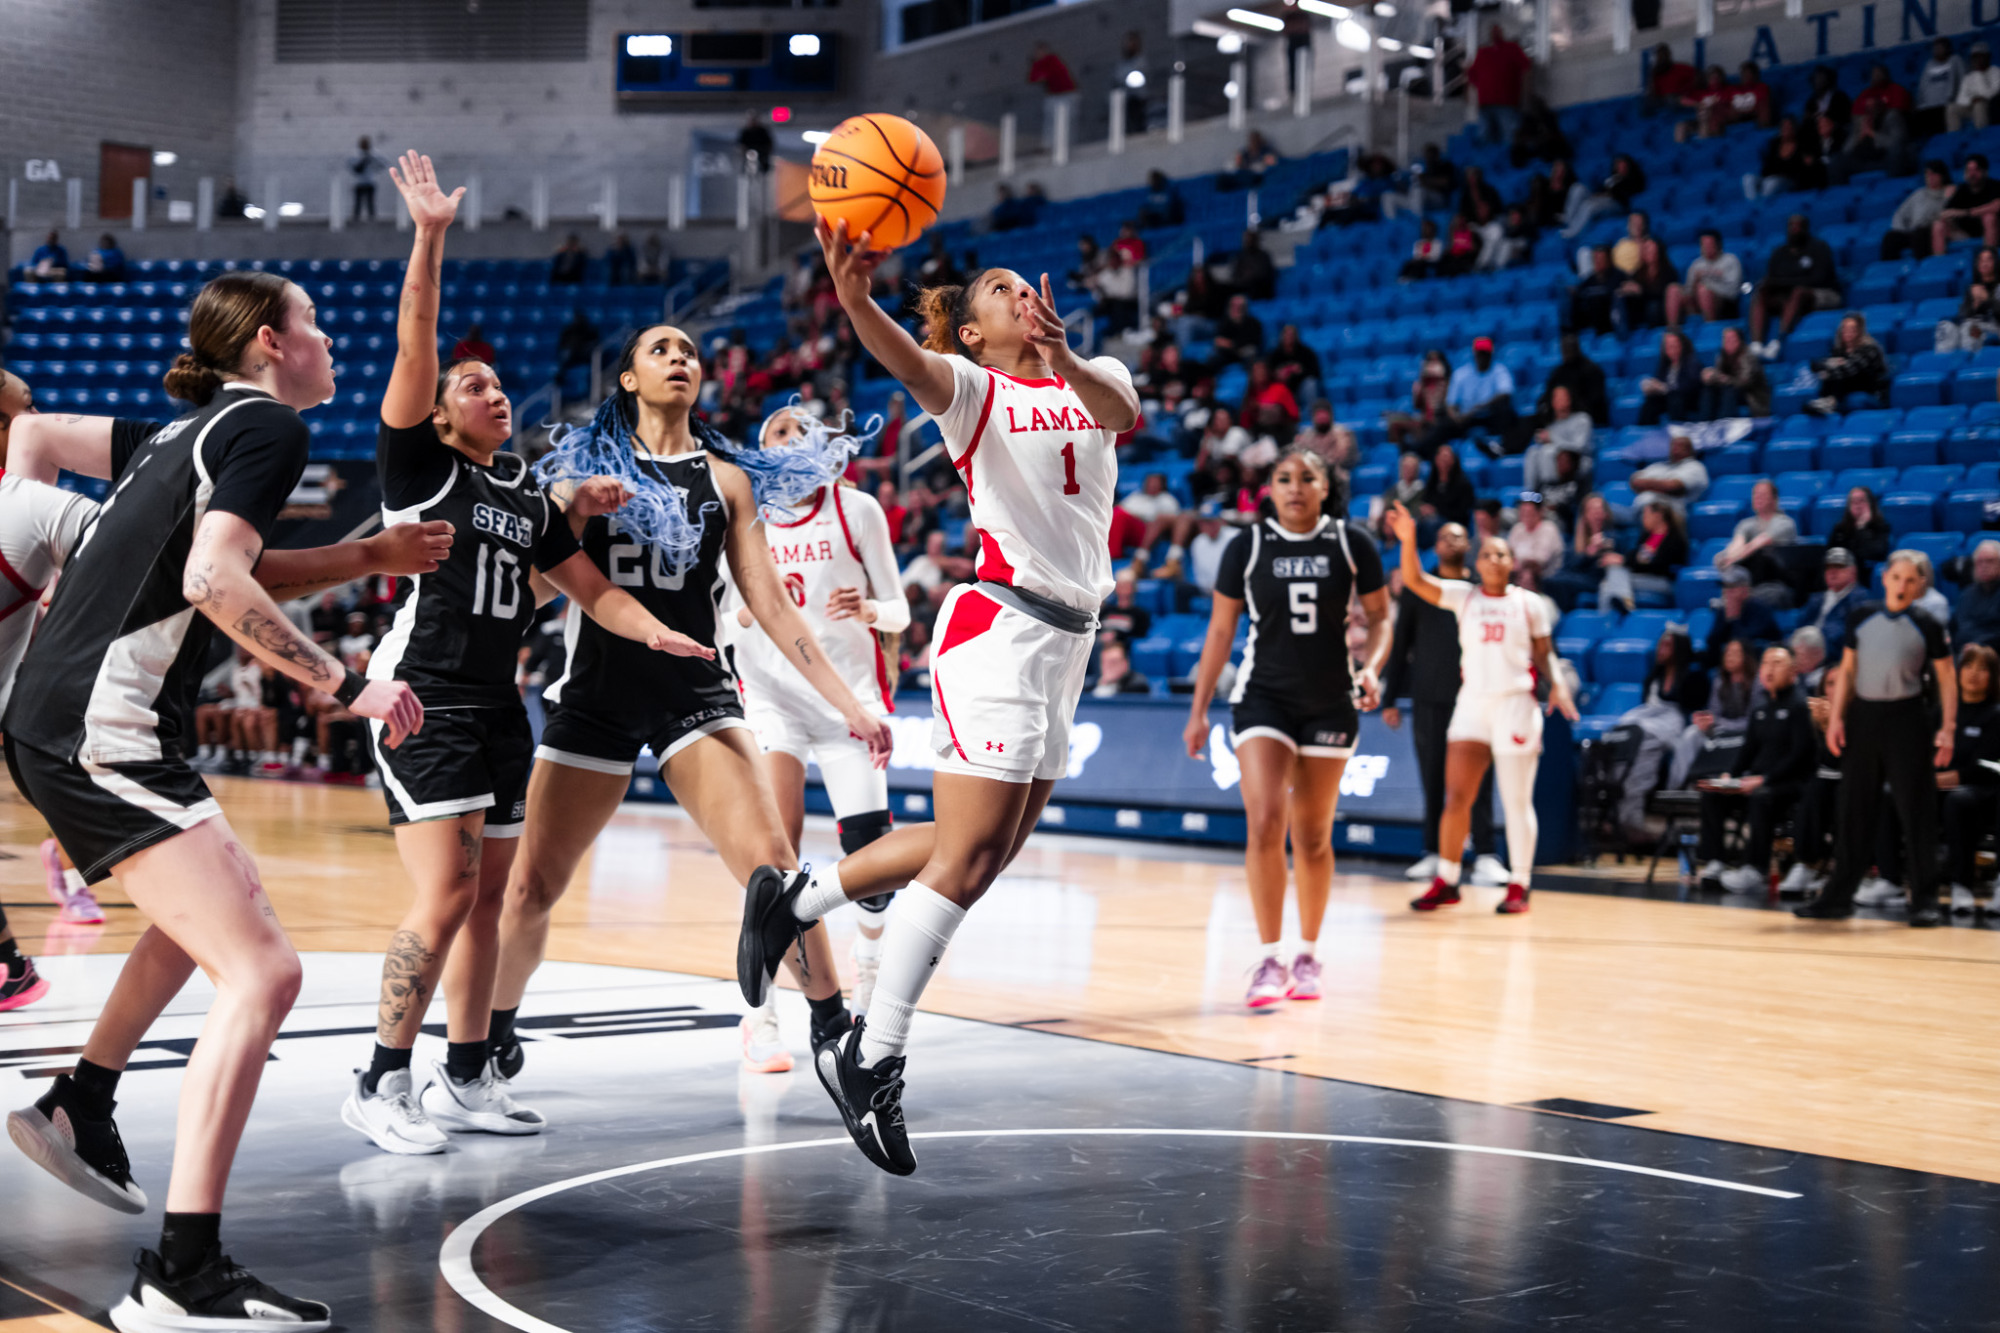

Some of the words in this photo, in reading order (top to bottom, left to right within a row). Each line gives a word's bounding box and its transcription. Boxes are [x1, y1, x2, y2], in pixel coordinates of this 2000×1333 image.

[26, 159, 61, 181] GA
[1006, 406, 1106, 433] LAMA
[1061, 442, 1080, 495] 1
[771, 541, 833, 564] AMAR
[472, 543, 522, 619] 10
[1289, 582, 1317, 634] 5
